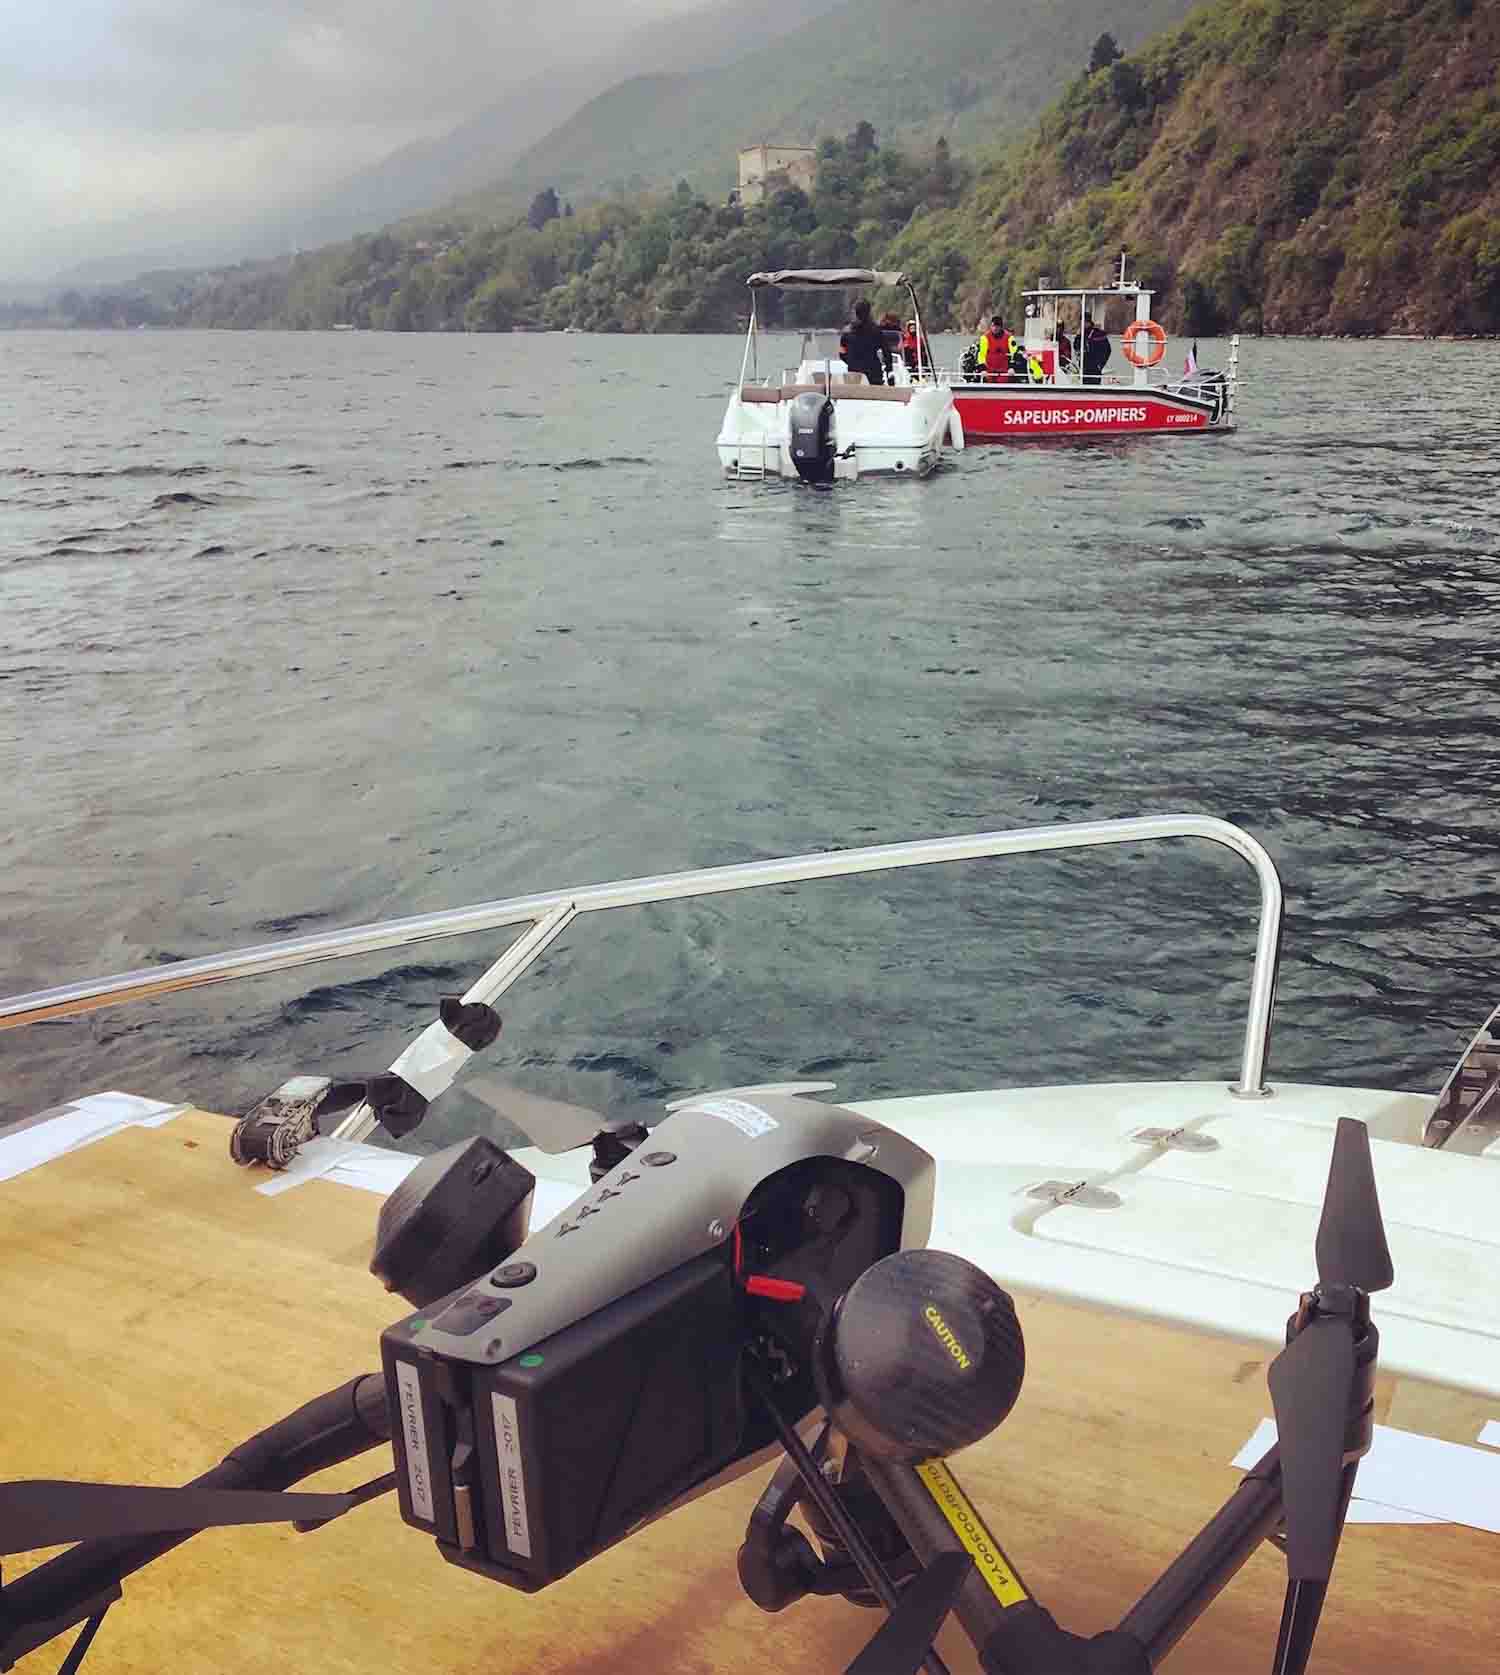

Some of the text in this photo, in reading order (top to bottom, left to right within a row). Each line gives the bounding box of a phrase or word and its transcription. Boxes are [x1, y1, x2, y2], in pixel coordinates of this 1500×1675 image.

[1003, 407, 1147, 425] SAPEURS-POMPIERS
[926, 1306, 971, 1369] CAUTION
[405, 1381, 426, 1504] FEVRIER 2017
[508, 1466, 522, 1536] FEVRIER
